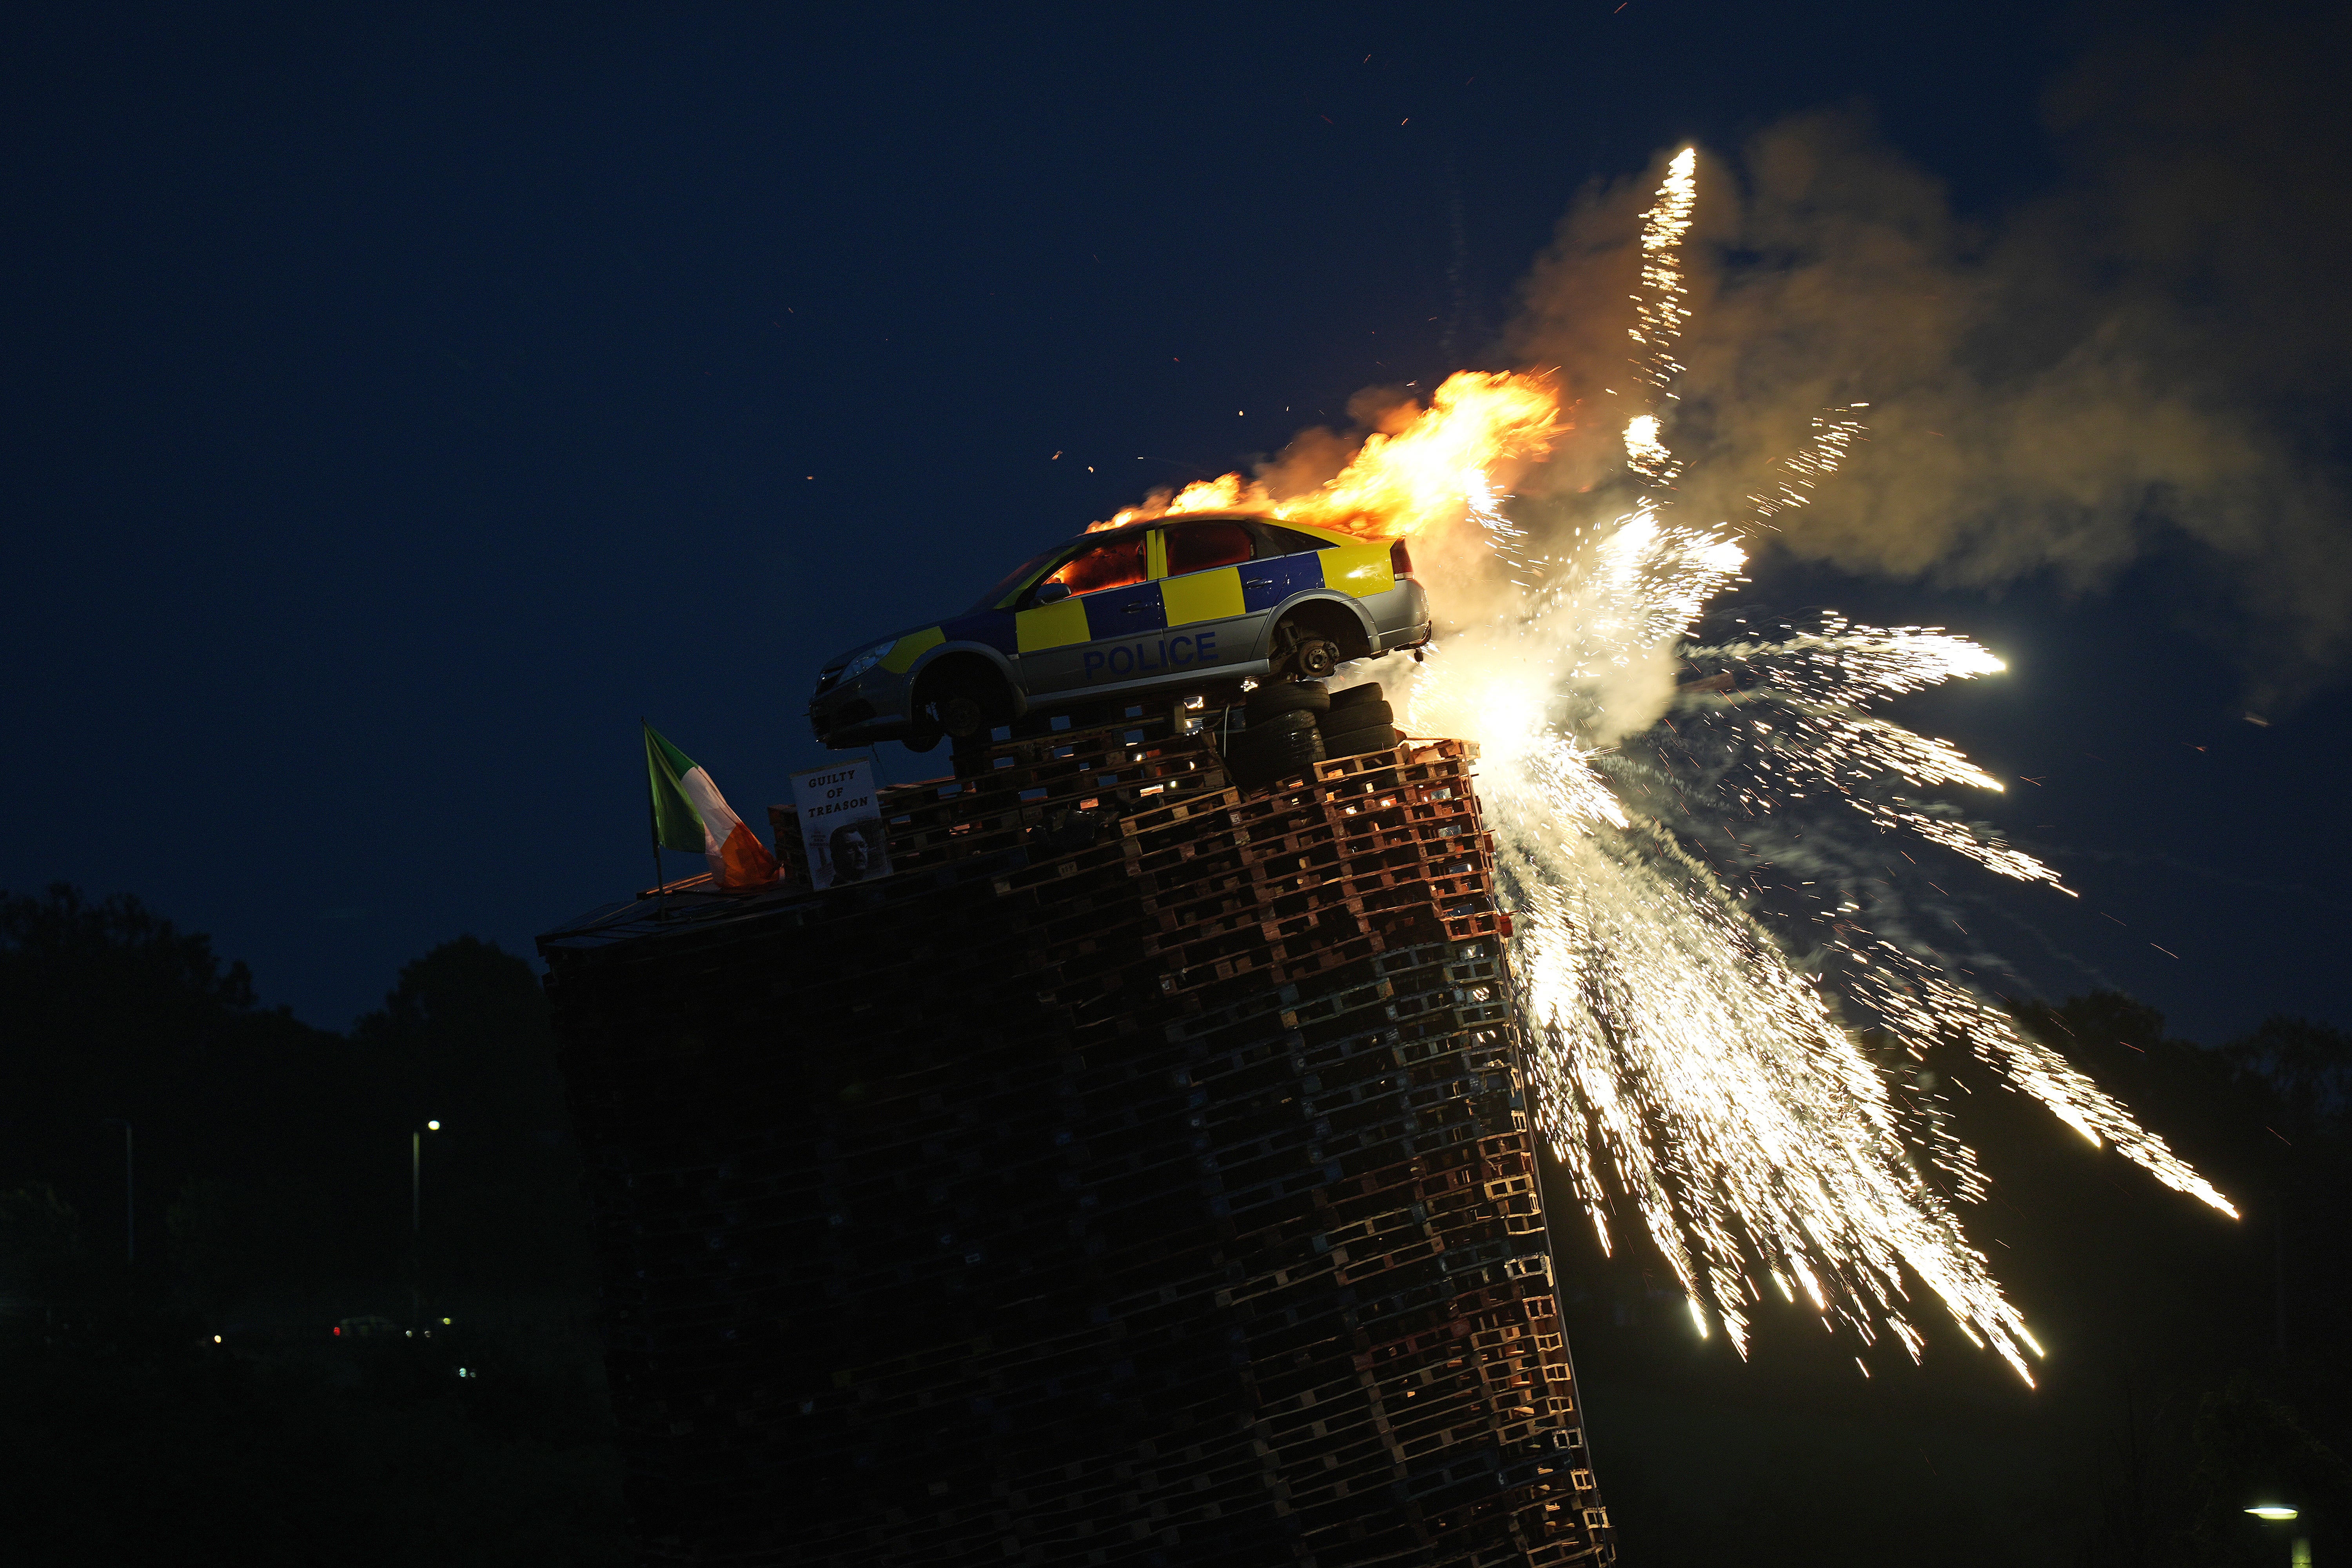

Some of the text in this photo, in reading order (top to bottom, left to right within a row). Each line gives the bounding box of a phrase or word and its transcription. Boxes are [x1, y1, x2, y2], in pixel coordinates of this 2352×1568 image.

[1083, 632, 1218, 680] POLICE
[809, 770, 855, 788] GUILTY
[827, 788, 843, 798] OF
[808, 797, 868, 817] TREASON
